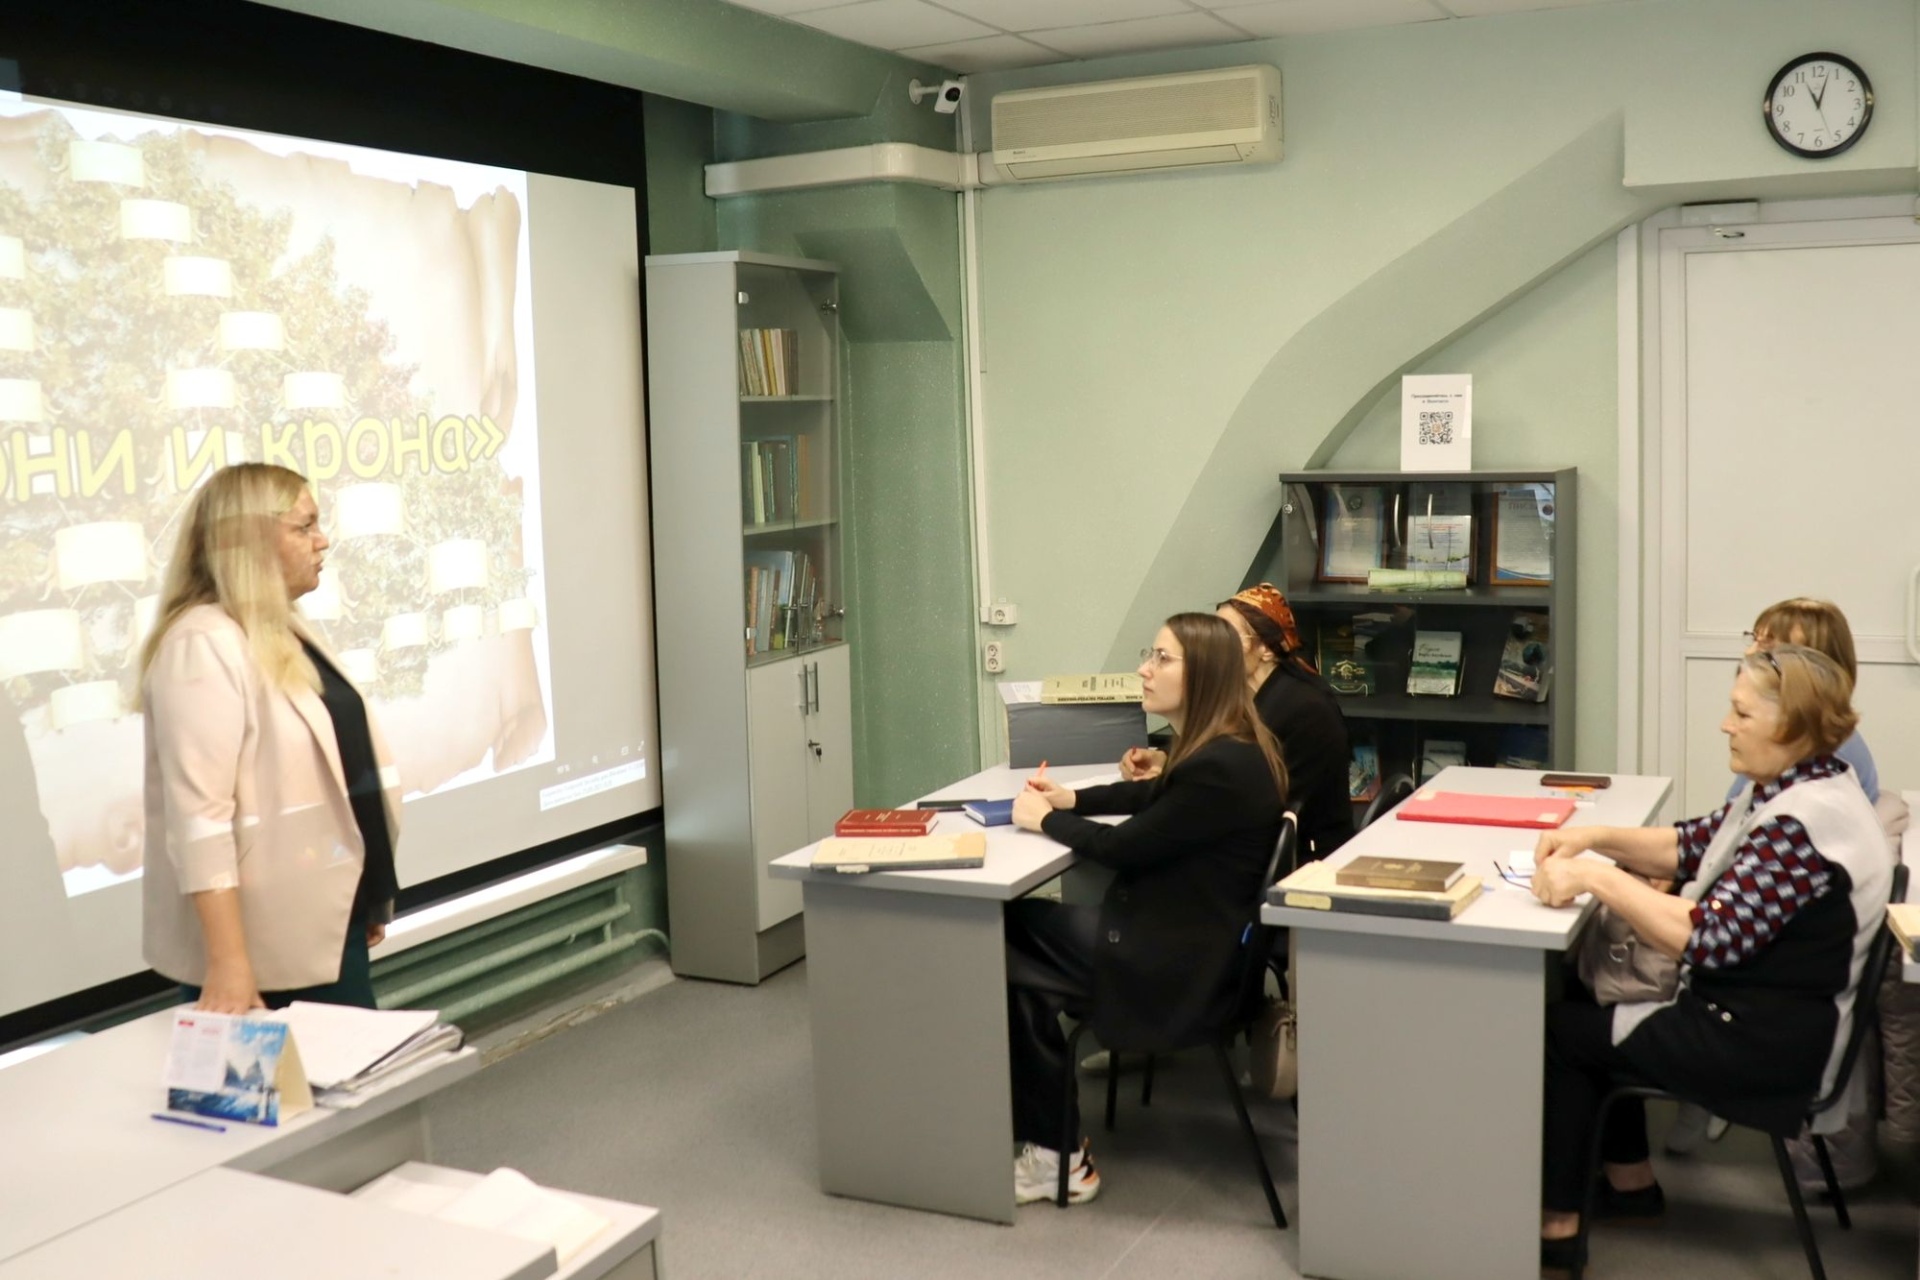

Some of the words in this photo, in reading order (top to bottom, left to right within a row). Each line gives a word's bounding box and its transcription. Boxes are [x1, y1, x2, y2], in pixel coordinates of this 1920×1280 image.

[1795, 72, 1806, 84] 11
[1812, 66, 1825, 78] 12
[1835, 68, 1840, 80] 1
[1782, 85, 1795, 97] 10
[1847, 80, 1855, 92] 2
[1854, 98, 1861, 110] 3
[1776, 105, 1784, 117] 9
[1783, 121, 1791, 133] 8
[1847, 116, 1855, 128] 4
[1797, 133, 1805, 145] 7
[1814, 137, 1823, 147] 6
[1834, 130, 1842, 142] 5
[0, 425, 137, 503] ни
[171, 423, 228, 492] и
[260, 412, 506, 503] крона»
